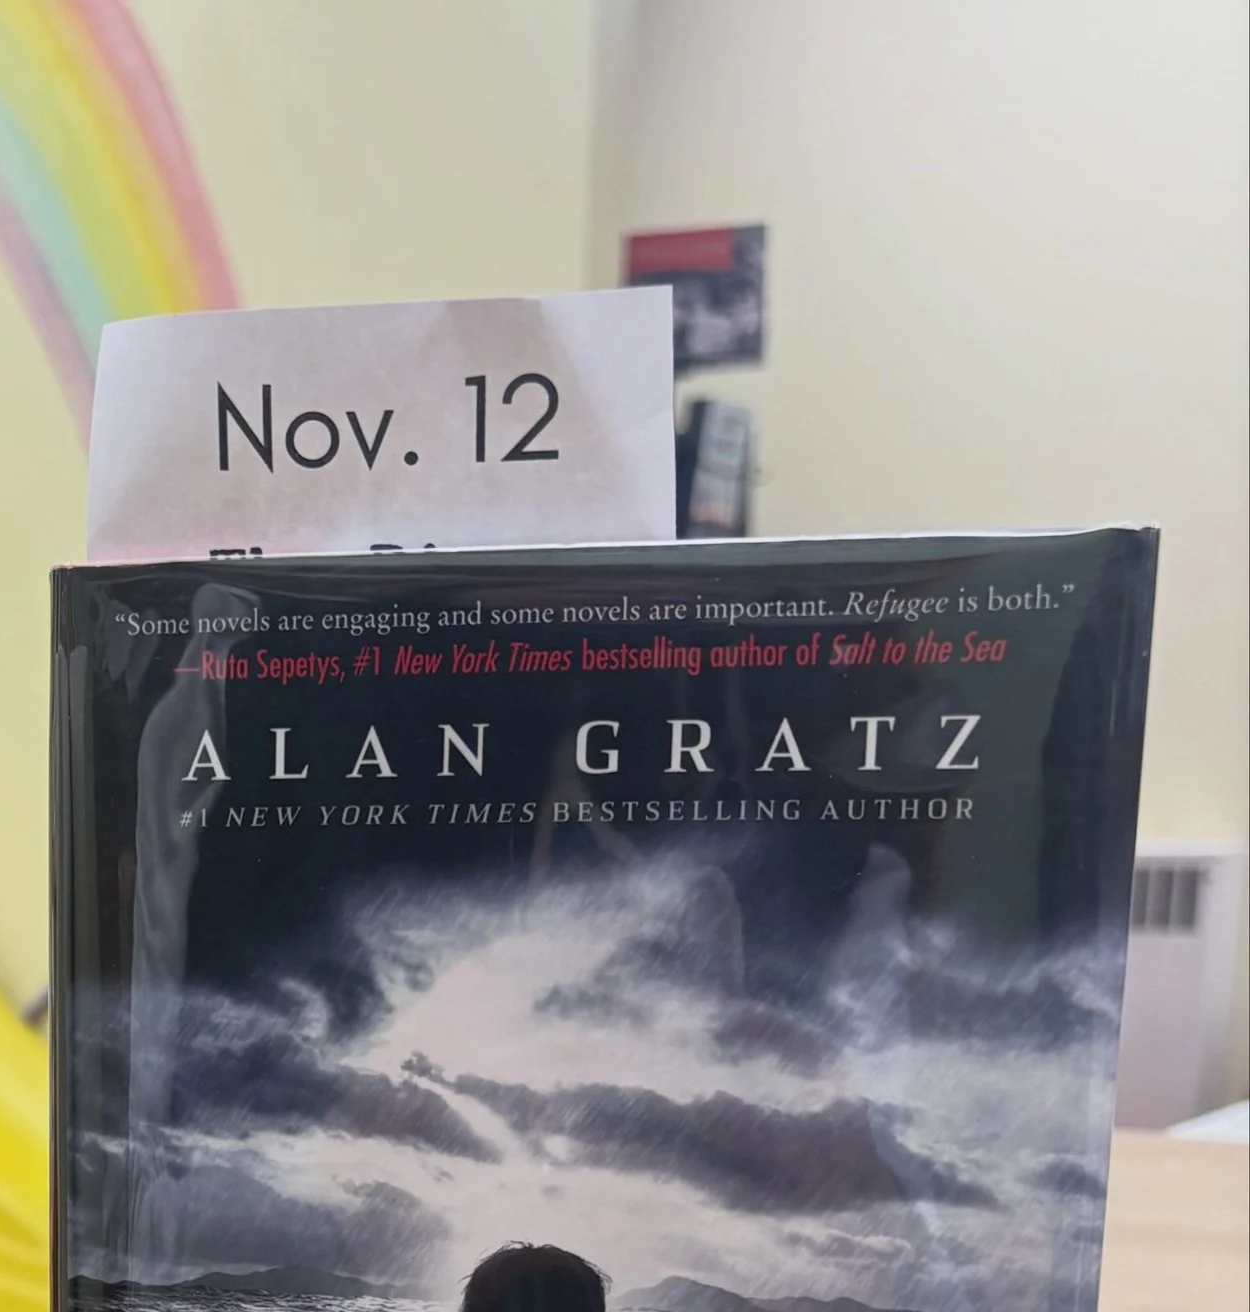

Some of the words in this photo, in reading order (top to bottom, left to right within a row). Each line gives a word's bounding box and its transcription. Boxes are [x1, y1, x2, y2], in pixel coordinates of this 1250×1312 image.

[217, 381, 419, 474] Nov.
[465, 372, 560, 463] 12
[197, 608, 271, 634] novels
[278, 615, 315, 632] are
[321, 606, 430, 637] engaging
[438, 600, 483, 627] and
[490, 608, 555, 626] some
[562, 595, 641, 622] novels
[648, 604, 687, 620] are
[695, 595, 835, 626] important.
[843, 588, 949, 622] Refugee
[957, 587, 978, 612] is
[256, 649, 347, 686] Sepetys,
[352, 645, 382, 676] #1
[393, 644, 443, 675] New
[450, 640, 501, 674] York
[507, 640, 572, 672] Times
[580, 635, 701, 676] bestselling
[709, 633, 787, 668] author
[795, 631, 822, 666] of
[829, 631, 874, 666] Salt
[882, 634, 908, 666] to
[913, 629, 954, 664] the
[959, 629, 1008, 662] Sea
[181, 723, 490, 782] ALAN
[575, 714, 982, 775] GRATZ
[179, 808, 208, 828] #1
[225, 805, 302, 827] NEW
[319, 803, 408, 825] YORK
[428, 801, 538, 823] TIMES
[553, 799, 802, 822] BESTSELLING
[819, 798, 974, 821] AUTHOR
